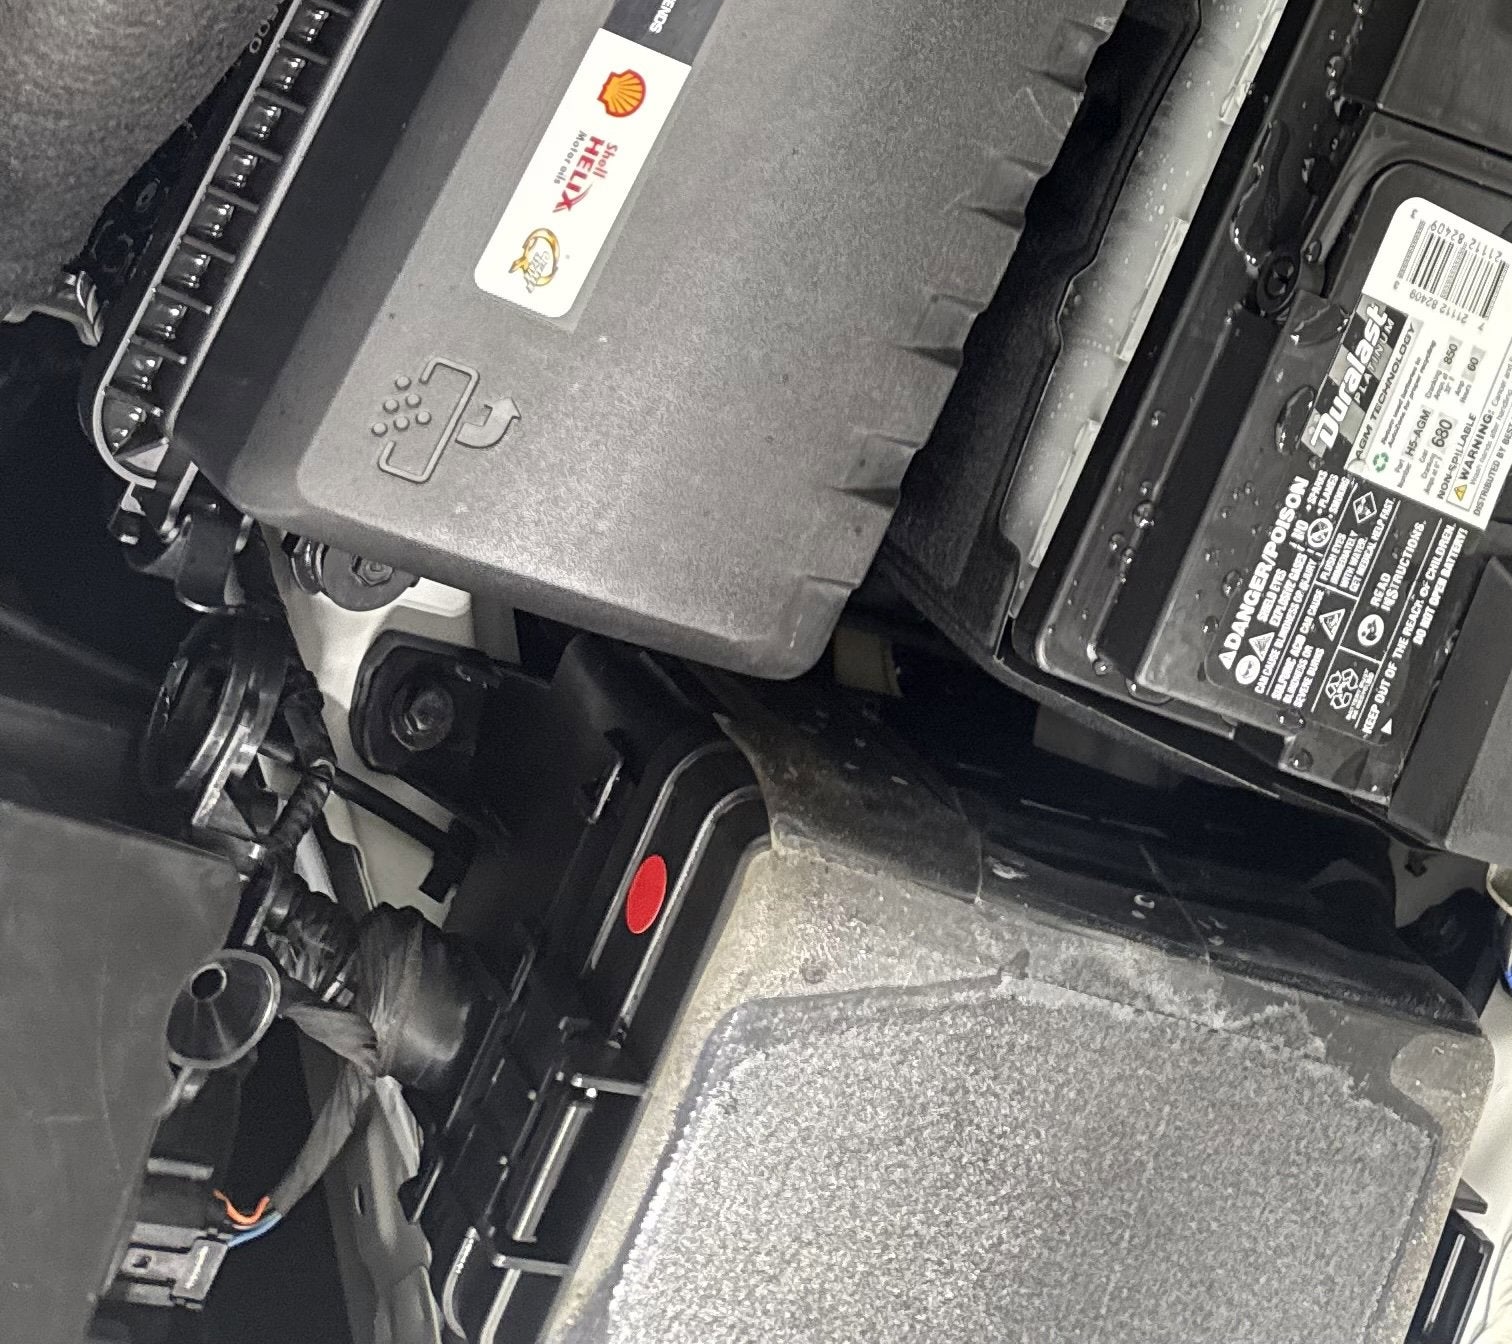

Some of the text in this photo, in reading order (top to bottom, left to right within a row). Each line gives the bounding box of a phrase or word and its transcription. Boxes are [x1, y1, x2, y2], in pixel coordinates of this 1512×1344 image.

[561, 129, 587, 166] Motor
[591, 141, 618, 179] Shell
[551, 134, 607, 219] HELIX
[1429, 219, 1465, 244] 82409
[1467, 237, 1502, 263] 21112
[1408, 288, 1438, 309] 82409
[1438, 302, 1468, 324] 21112
[1309, 300, 1390, 452] Duralast
[1352, 317, 1395, 405] PLATINUM
[1442, 342, 1458, 365] 850
[1466, 356, 1479, 372] 60
[1353, 321, 1417, 460] AGM TECHNOLOGY
[1405, 409, 1430, 456] H5-AGM
[1430, 417, 1453, 448] 680
[1458, 408, 1495, 481] WARNING:
[1501, 362, 1512, 379] and
[1435, 412, 1478, 499] NON-SPILLABLE
[1469, 462, 1483, 485] Wash
[1477, 438, 1492, 462] hands
[1306, 469, 1328, 504] SPARKS
[1318, 472, 1339, 508] FLAMES
[1328, 476, 1350, 513] SMOKING
[1471, 459, 1501, 516] DISTRIBUTED
[1495, 444, 1507, 459] BY
[1290, 518, 1309, 541] NO
[1349, 495, 1396, 593] GET MEDICAL HELP FAST.
[1223, 474, 1310, 652] DANGER/POISON
[1320, 532, 1346, 581] FLUSH EYES
[1339, 565, 1355, 588] WITH
[1380, 517, 1427, 612] INSTRUCTIONS.
[1256, 567, 1287, 623] SHIELD EYES
[1268, 551, 1308, 627] EXPLOSIVE GASES
[1306, 587, 1325, 616] CAUSE
[1369, 571, 1392, 607] READ
[1412, 527, 1469, 645] DO NOT OPEN BATTERY!
[1273, 601, 1300, 649] BLINDNESS
[1361, 702, 1382, 734] KEEP
[1373, 678, 1392, 703] OUT
[1384, 660, 1399, 679] OF
[1392, 636, 1409, 659] THE
[1401, 597, 1425, 636] REACH
[1424, 520, 1457, 581] CHILDREN.
[1254, 675, 1269, 694] CAN
[1261, 647, 1280, 677] CAUSE
[1293, 646, 1325, 708] SEVERE BURNS
